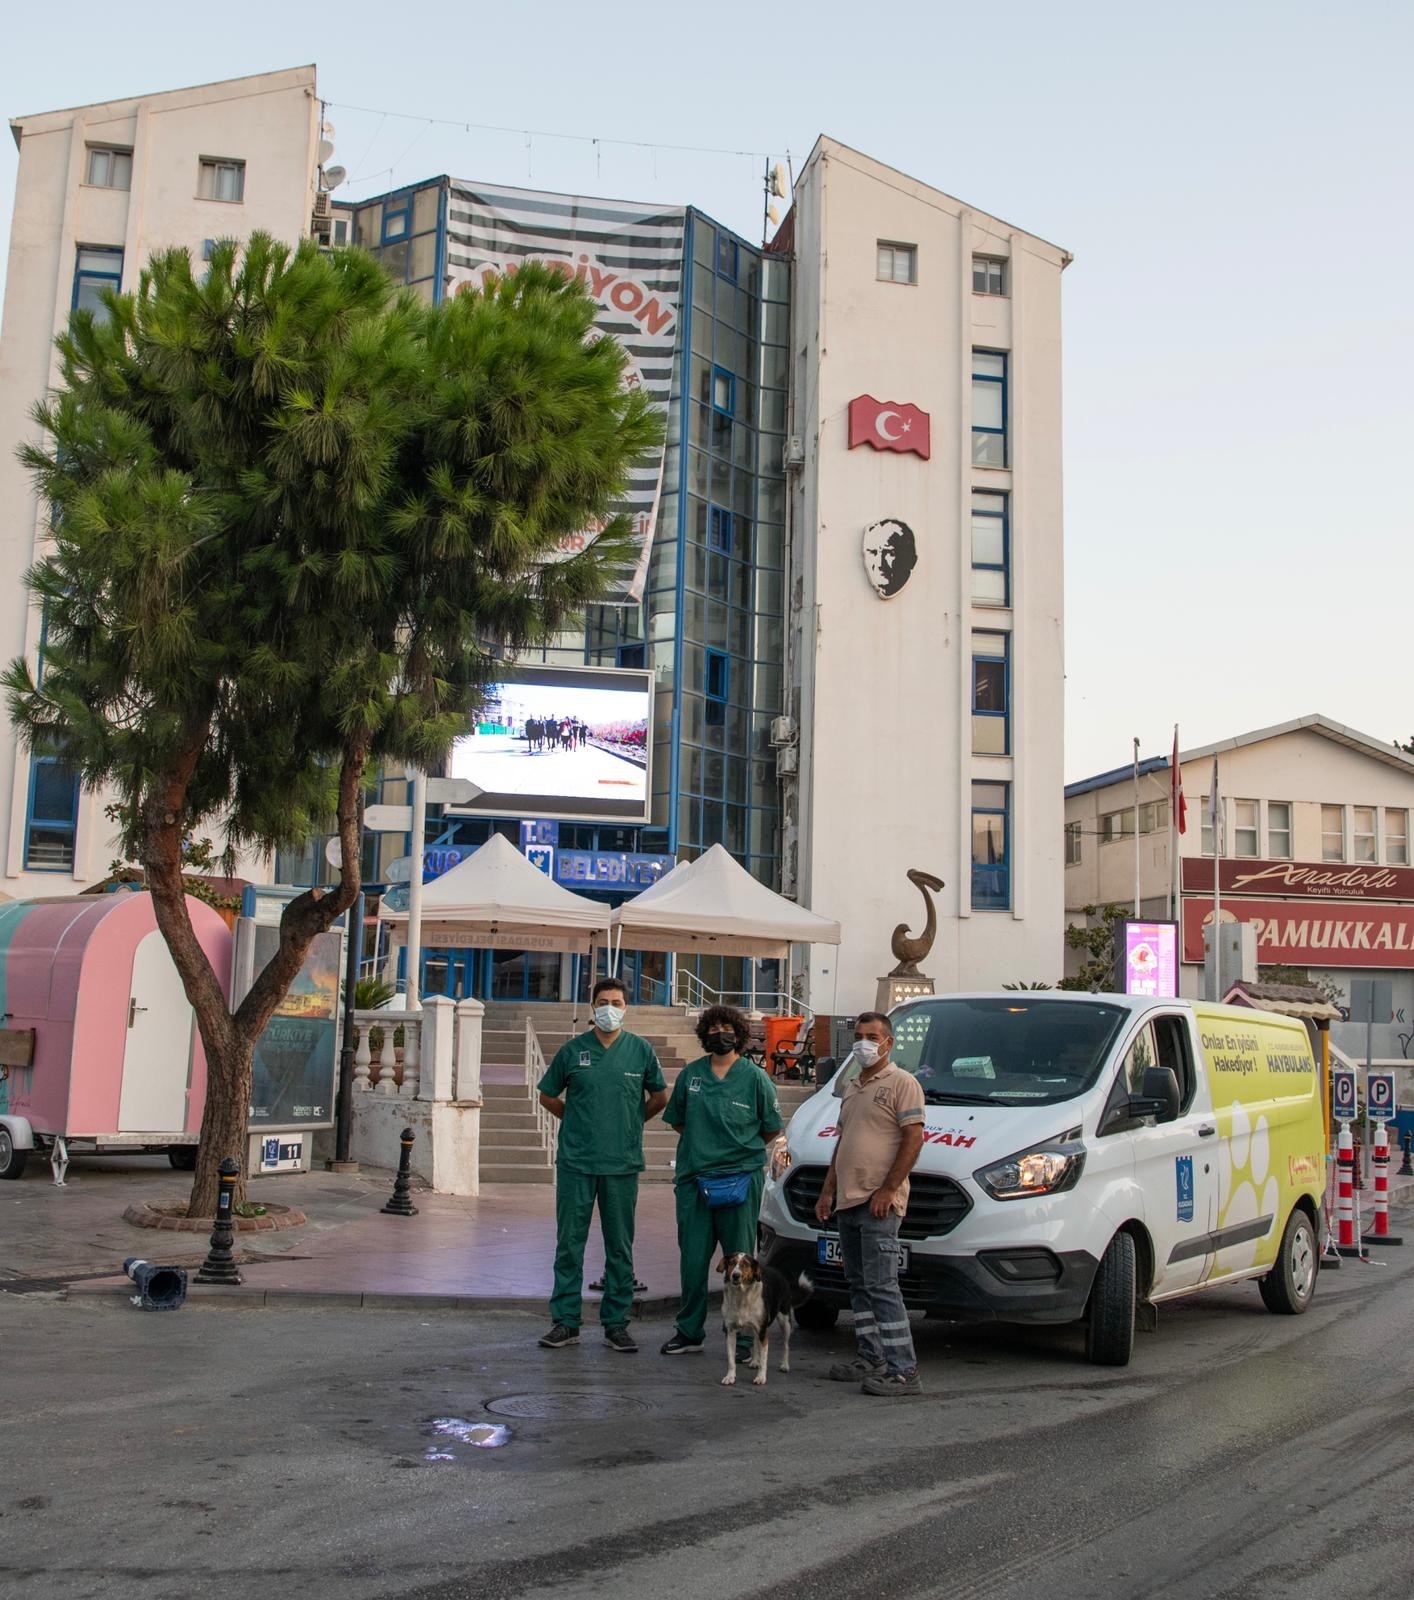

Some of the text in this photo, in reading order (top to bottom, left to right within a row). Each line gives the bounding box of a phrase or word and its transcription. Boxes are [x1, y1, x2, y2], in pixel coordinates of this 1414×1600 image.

[521, 820, 557, 843] T.C.
[1231, 863, 1397, 889] Anadolu
[1307, 886, 1365, 896] Keyifli Yolculuk
[1249, 917, 1414, 951] PAMUKKAL
[1201, 1033, 1224, 1050] Onlar
[1225, 1034, 1237, 1050] En
[287, 1145, 298, 1159] 11
